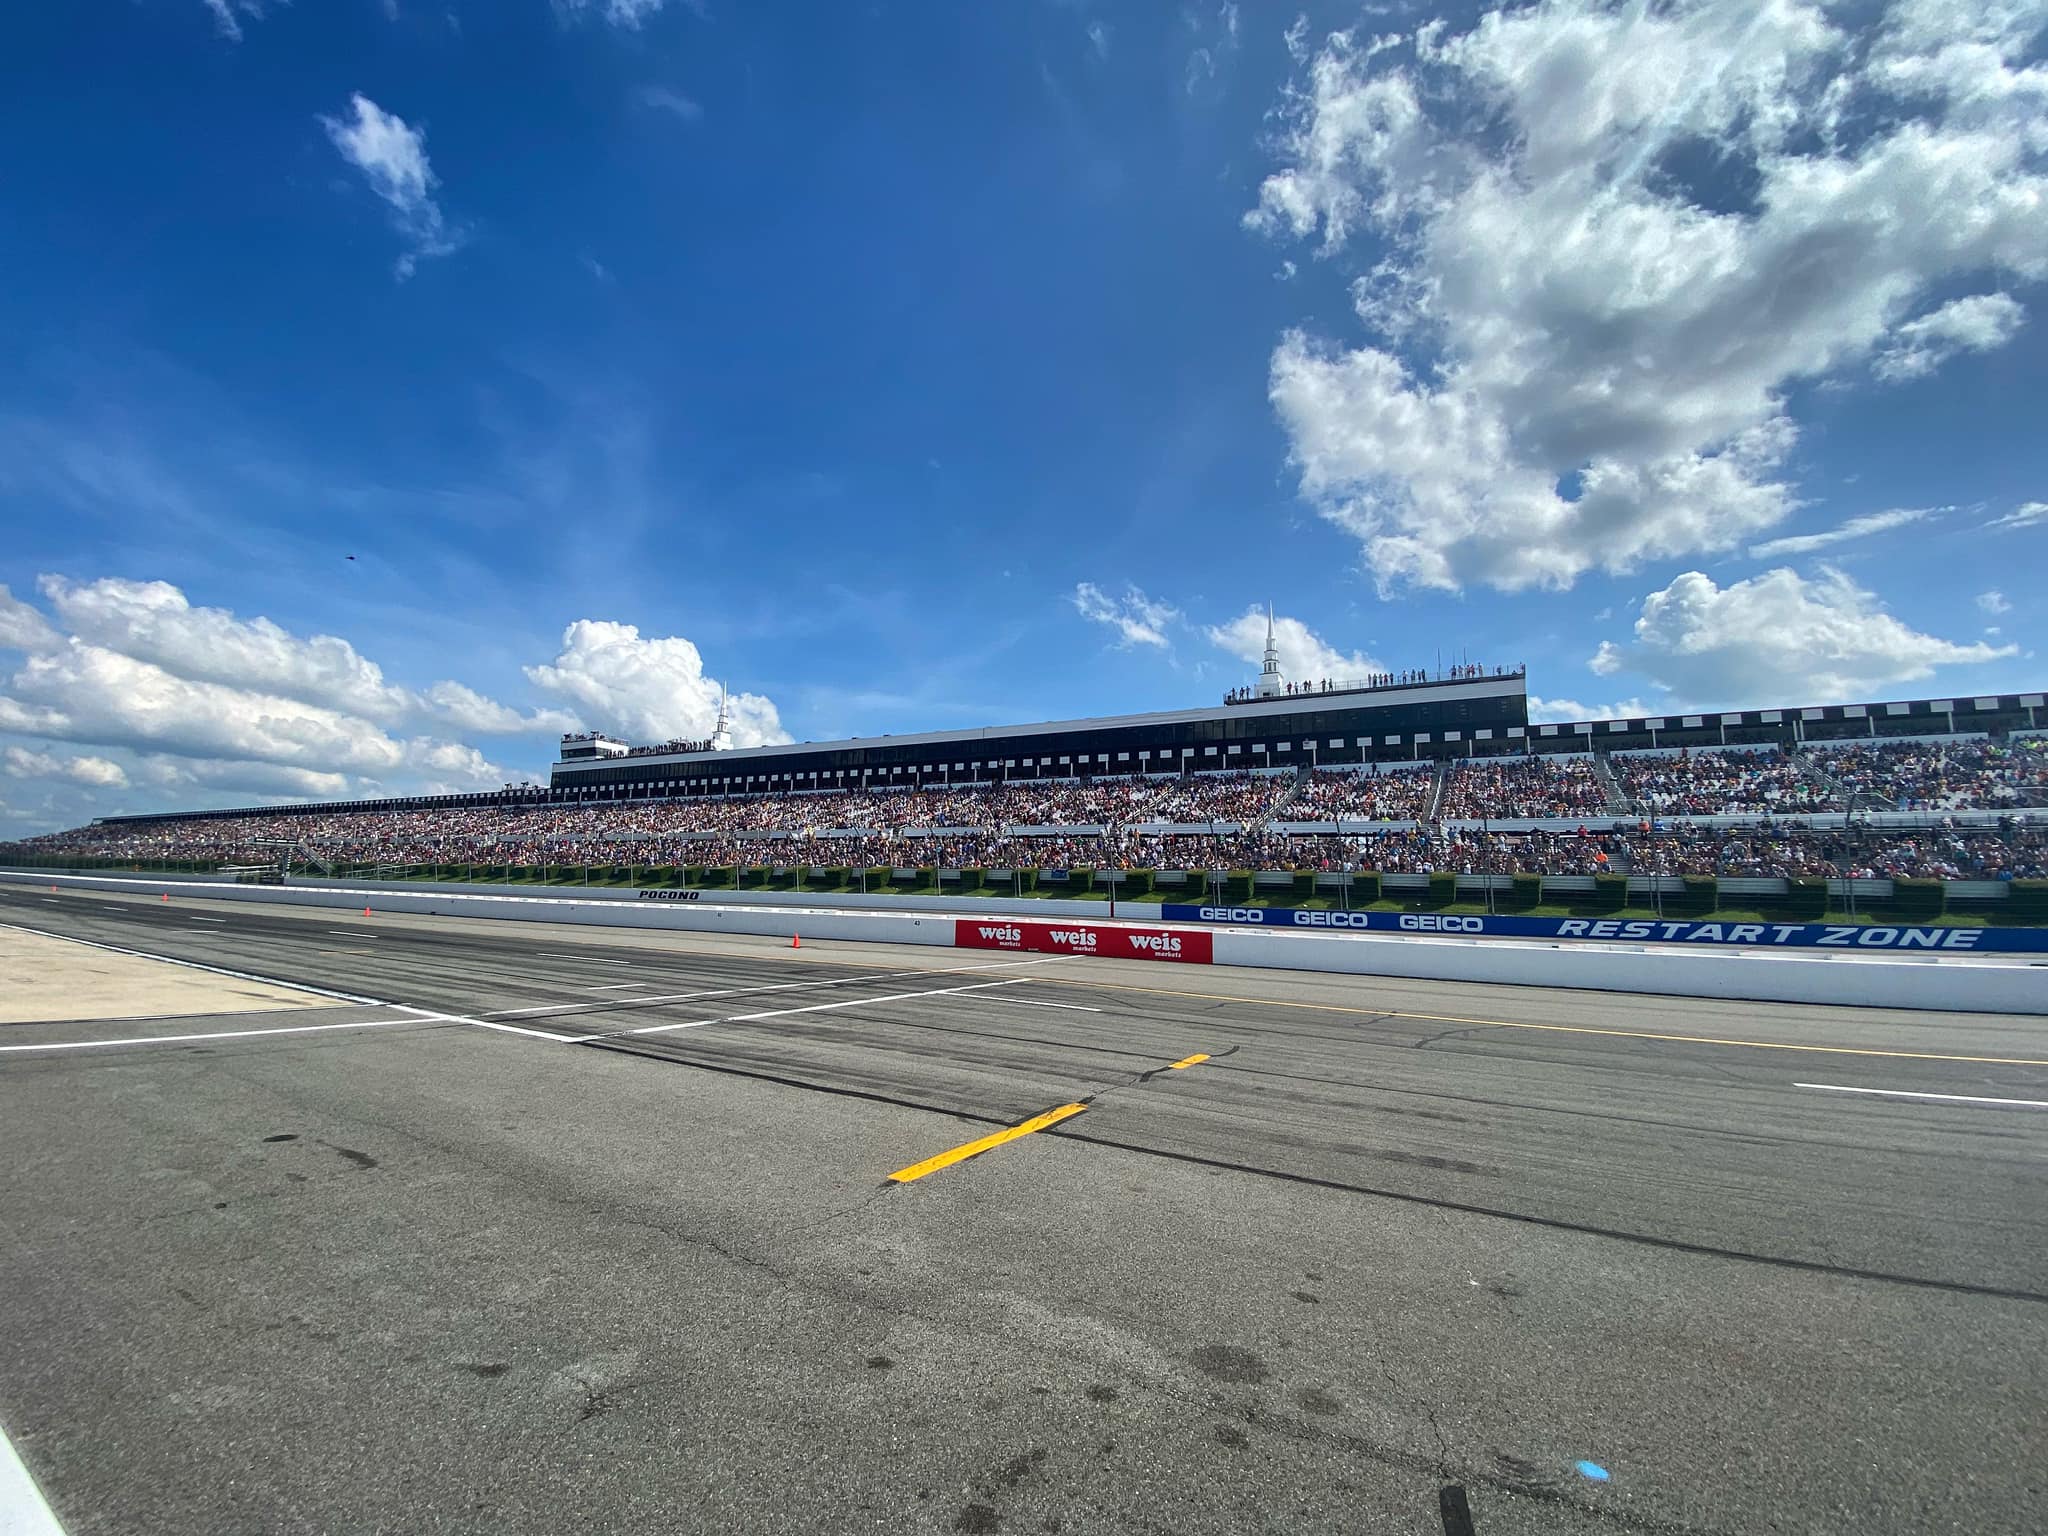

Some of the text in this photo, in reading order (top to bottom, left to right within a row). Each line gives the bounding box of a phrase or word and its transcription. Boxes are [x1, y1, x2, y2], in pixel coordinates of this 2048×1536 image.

[639, 891, 699, 900] POCONO
[1199, 907, 1263, 922] GEICO
[1294, 910, 1368, 928] GEICO
[1398, 914, 1484, 932] GEICO
[979, 924, 1021, 941] weis
[1050, 929, 1096, 945] weis
[1557, 920, 1983, 948] RESTART ZONE
[1129, 933, 1182, 950] weis
